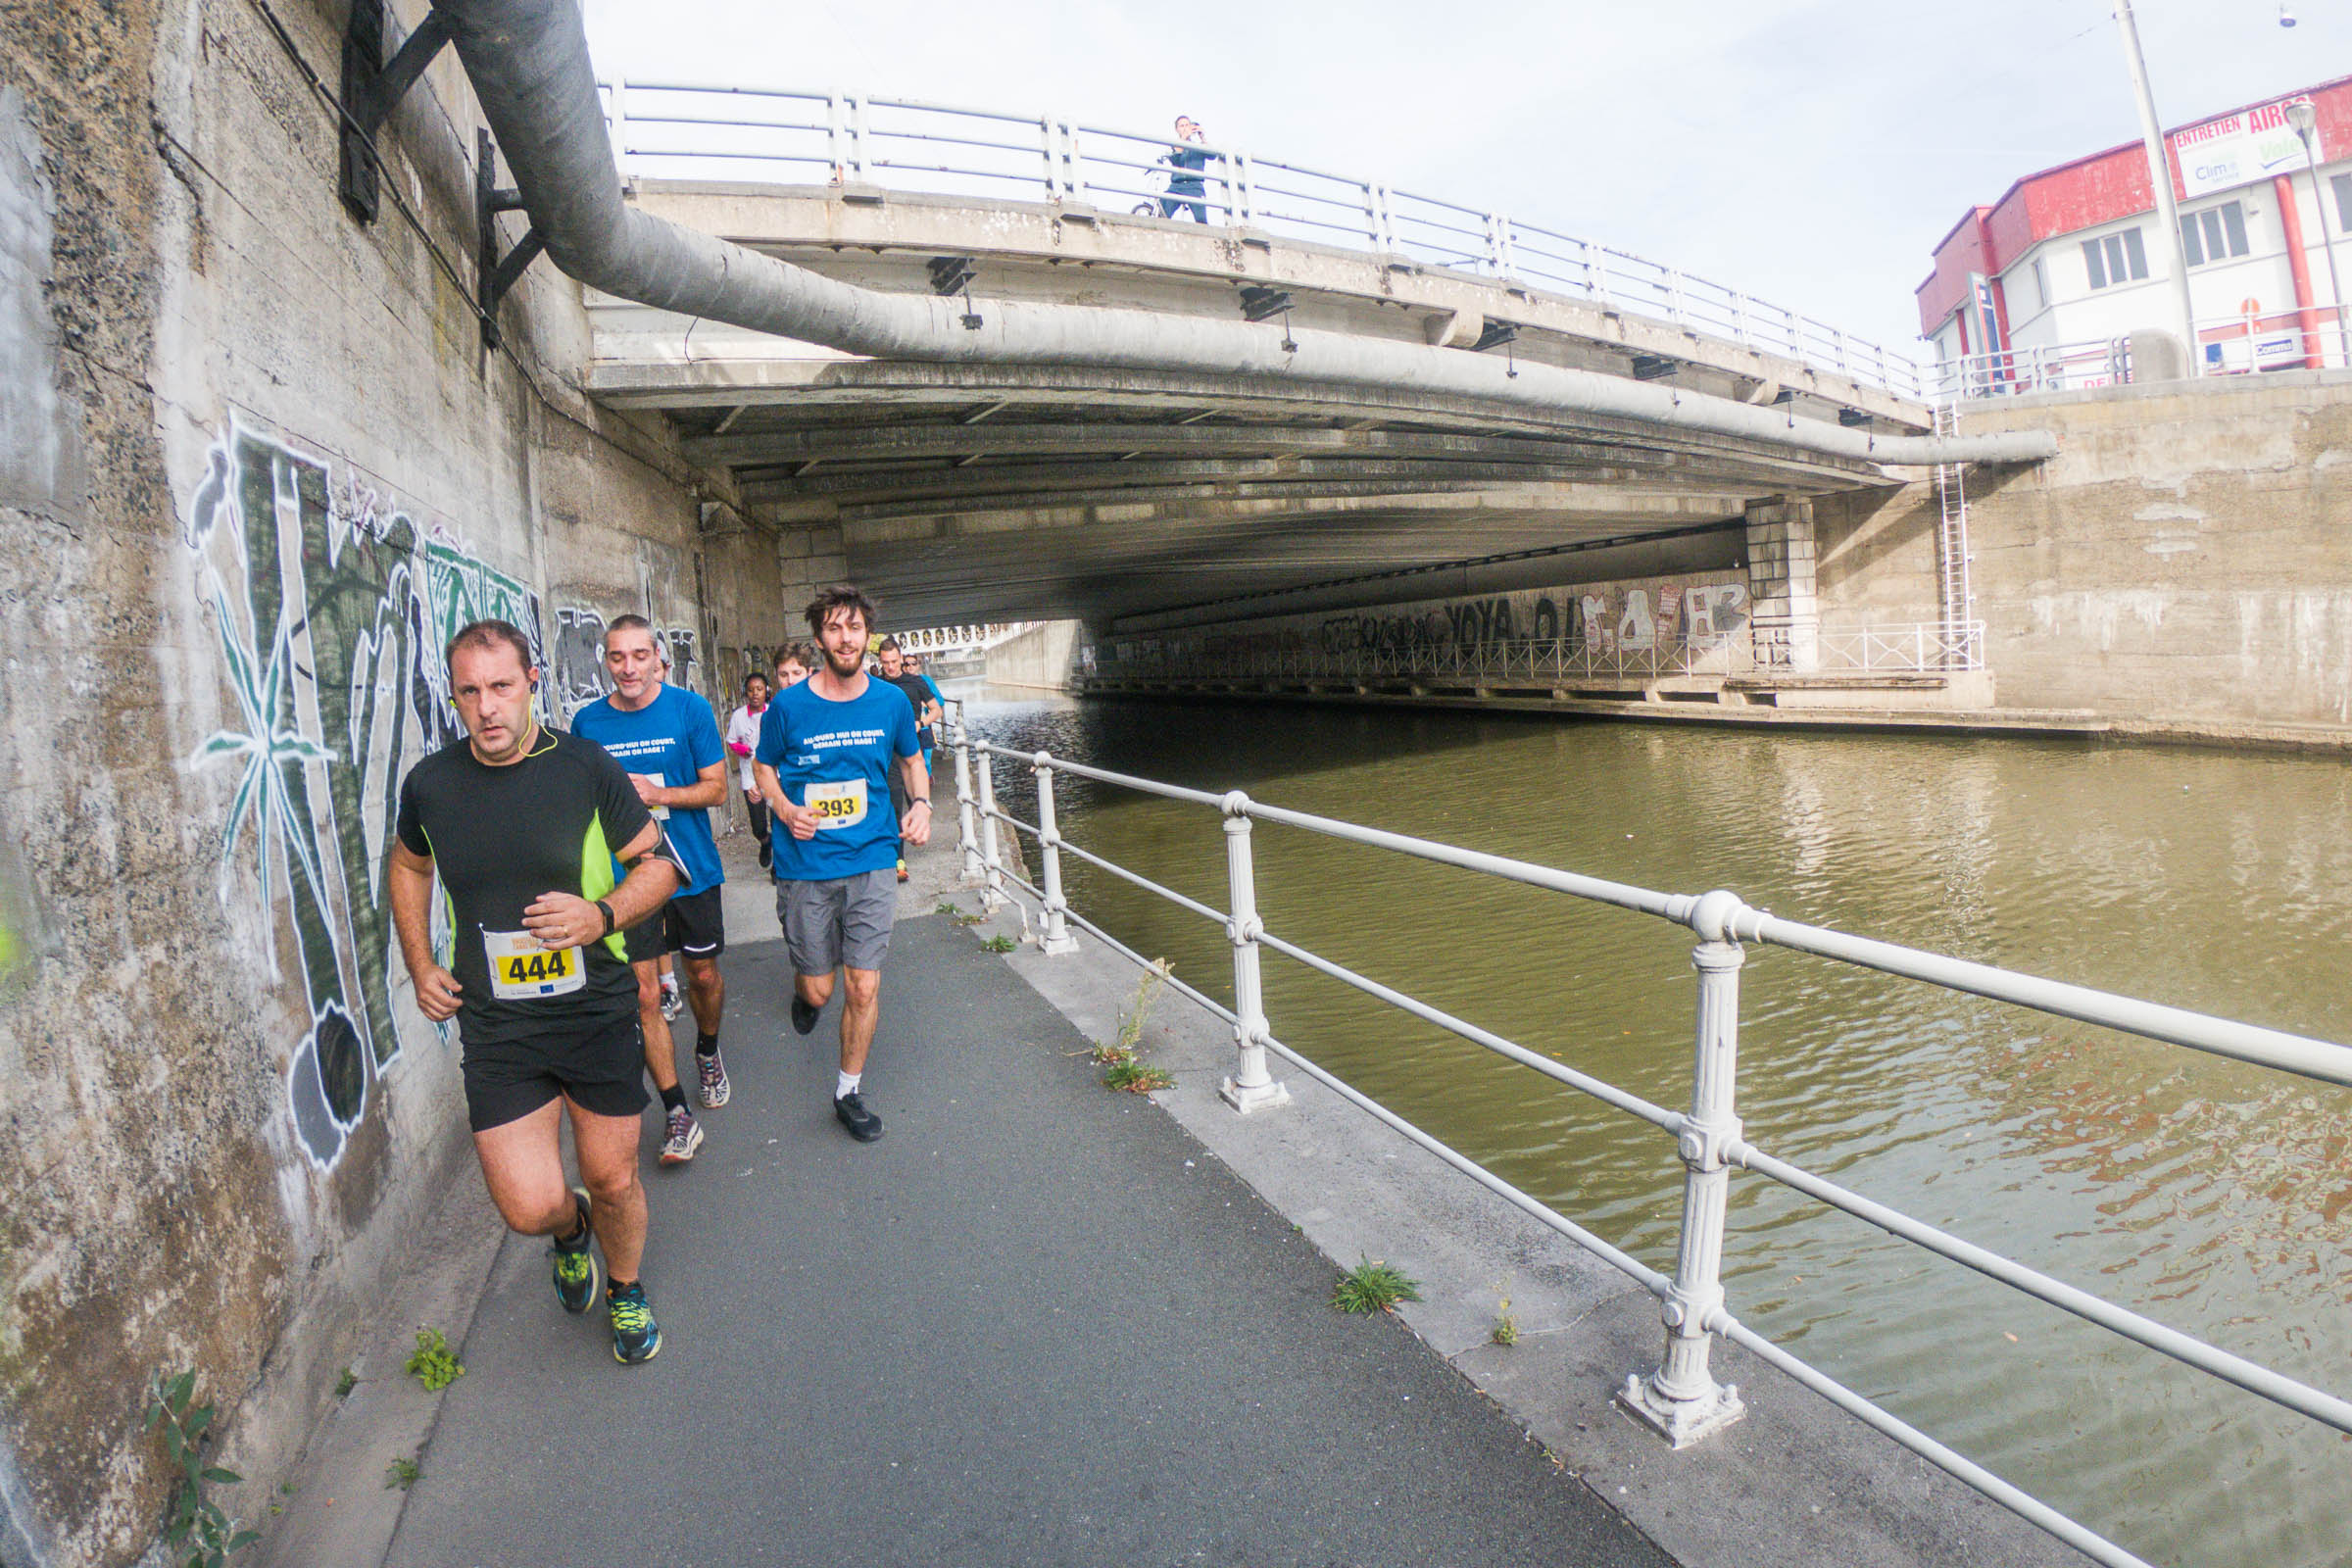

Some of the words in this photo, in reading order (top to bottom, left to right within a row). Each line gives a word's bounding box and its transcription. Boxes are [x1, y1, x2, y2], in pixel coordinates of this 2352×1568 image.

[2177, 117, 2241, 148] ENTRETIEN
[2248, 96, 2309, 134] AIRC
[2195, 164, 2228, 180] Clim
[812, 740, 841, 750] DEMAIN
[818, 798, 855, 817] 393
[509, 952, 566, 982] 444
